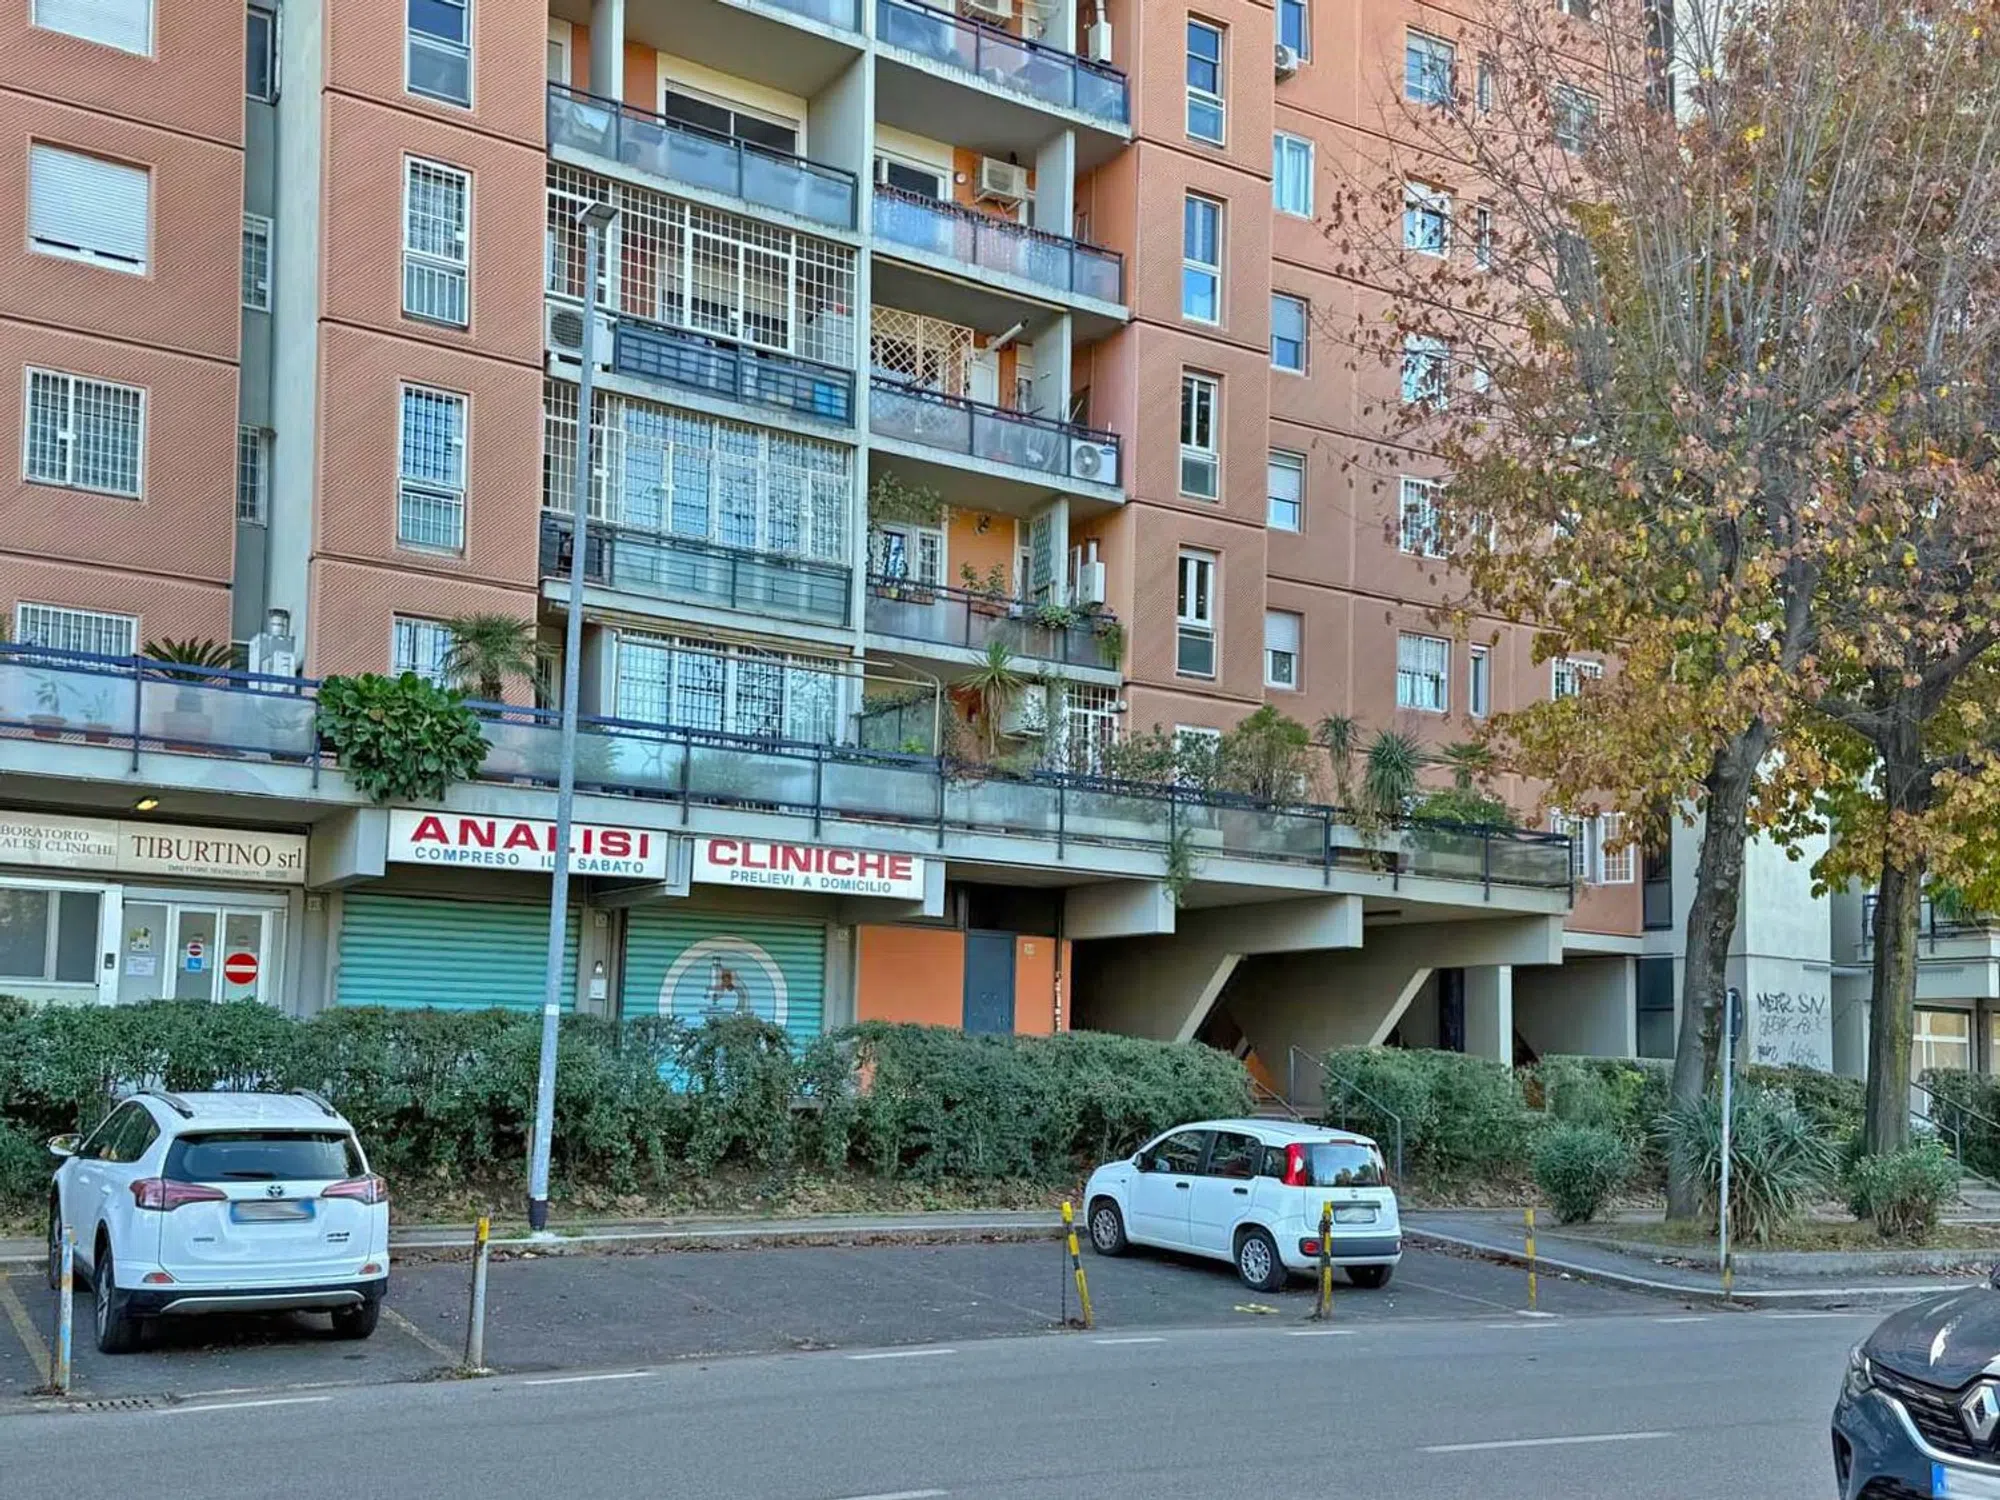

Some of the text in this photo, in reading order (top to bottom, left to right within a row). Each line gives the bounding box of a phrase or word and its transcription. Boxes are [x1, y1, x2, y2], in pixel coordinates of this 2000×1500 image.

[0, 824, 90, 842] BORATORIO
[411, 815, 649, 859] ANALISI
[132, 835, 302, 869] TIBURTINO srl
[414, 845, 644, 874] COMPRESO IL SABATO
[708, 839, 912, 881] CLINICHE
[730, 870, 891, 893] PRELIEVI A DOMICILIO
